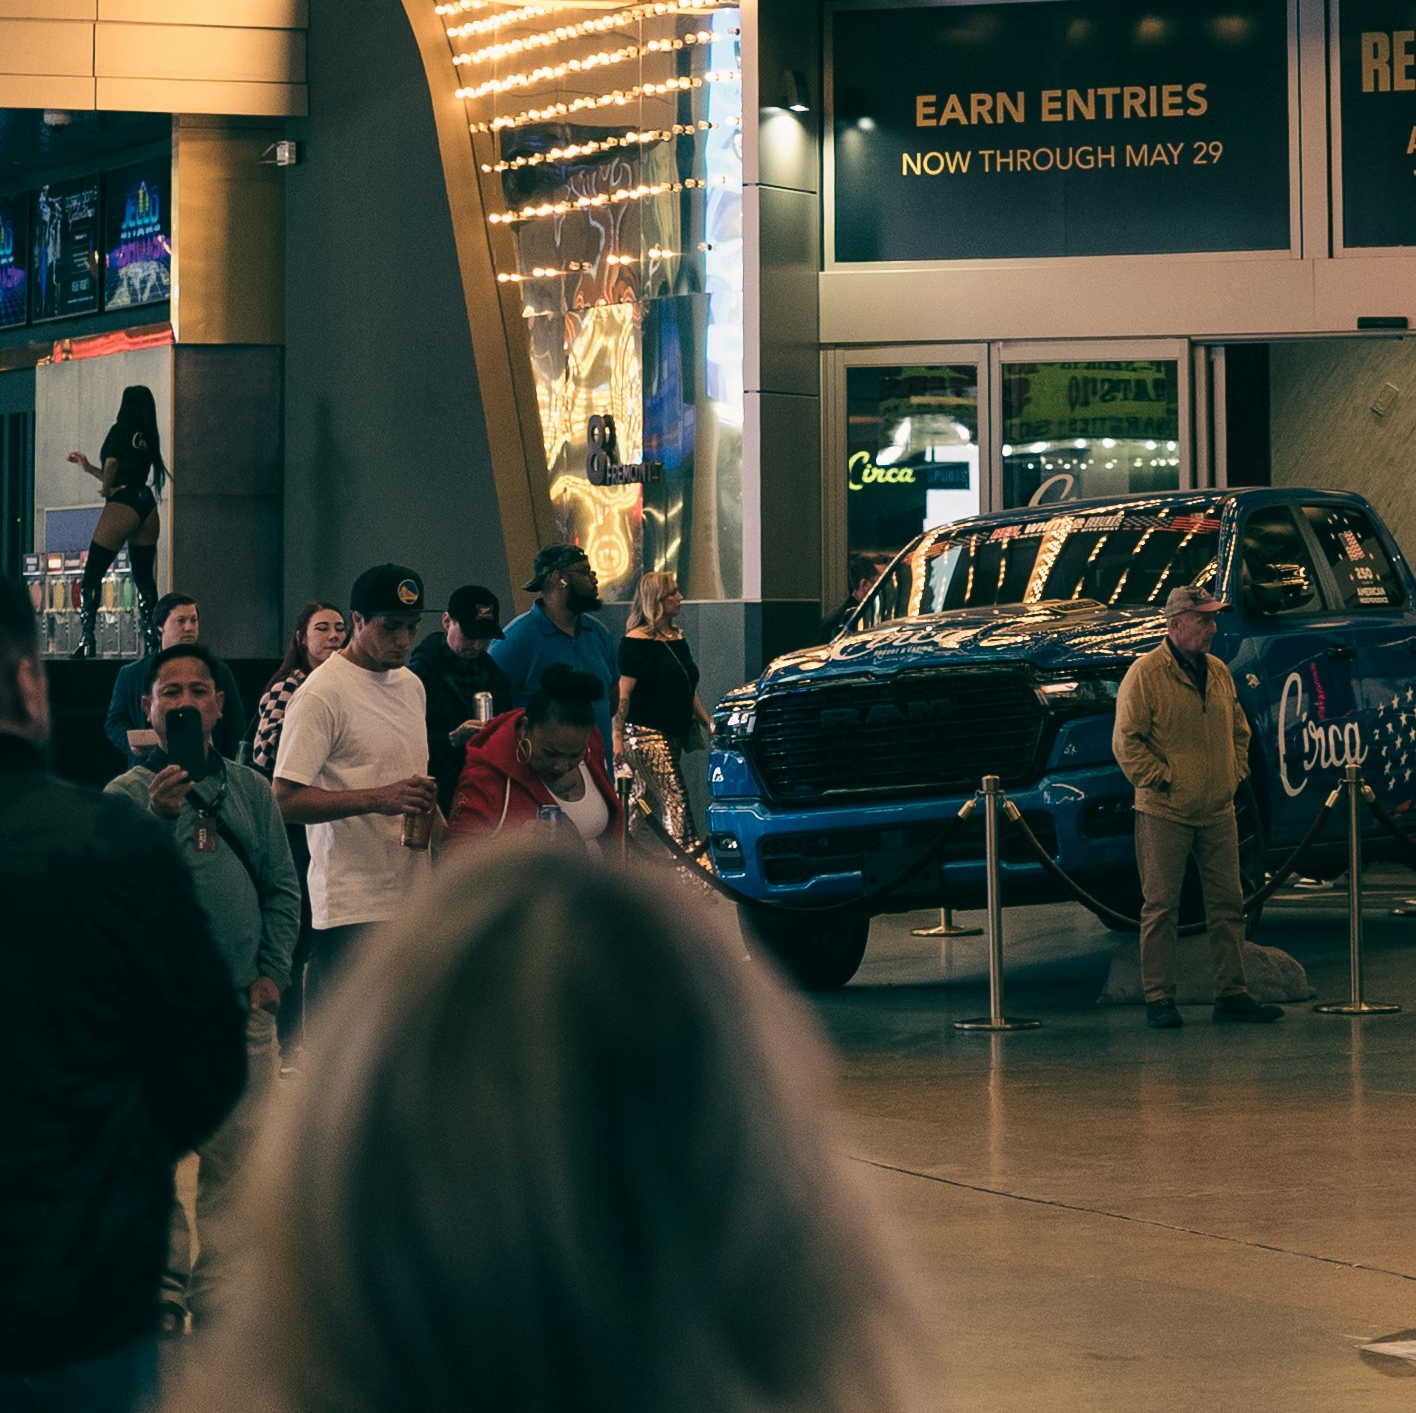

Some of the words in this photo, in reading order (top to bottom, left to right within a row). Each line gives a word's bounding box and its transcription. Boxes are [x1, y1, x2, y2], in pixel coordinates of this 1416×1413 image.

[915, 91, 1025, 127] EARN
[1041, 83, 1208, 122] ENTRIES
[902, 150, 972, 176] NOW
[979, 145, 1115, 173] THROUGH
[1125, 142, 1184, 168] MAY
[1193, 140, 1224, 165] 29
[848, 451, 917, 491] Circa
[820, 699, 954, 728] RAM
[1278, 672, 1369, 797] Circa
